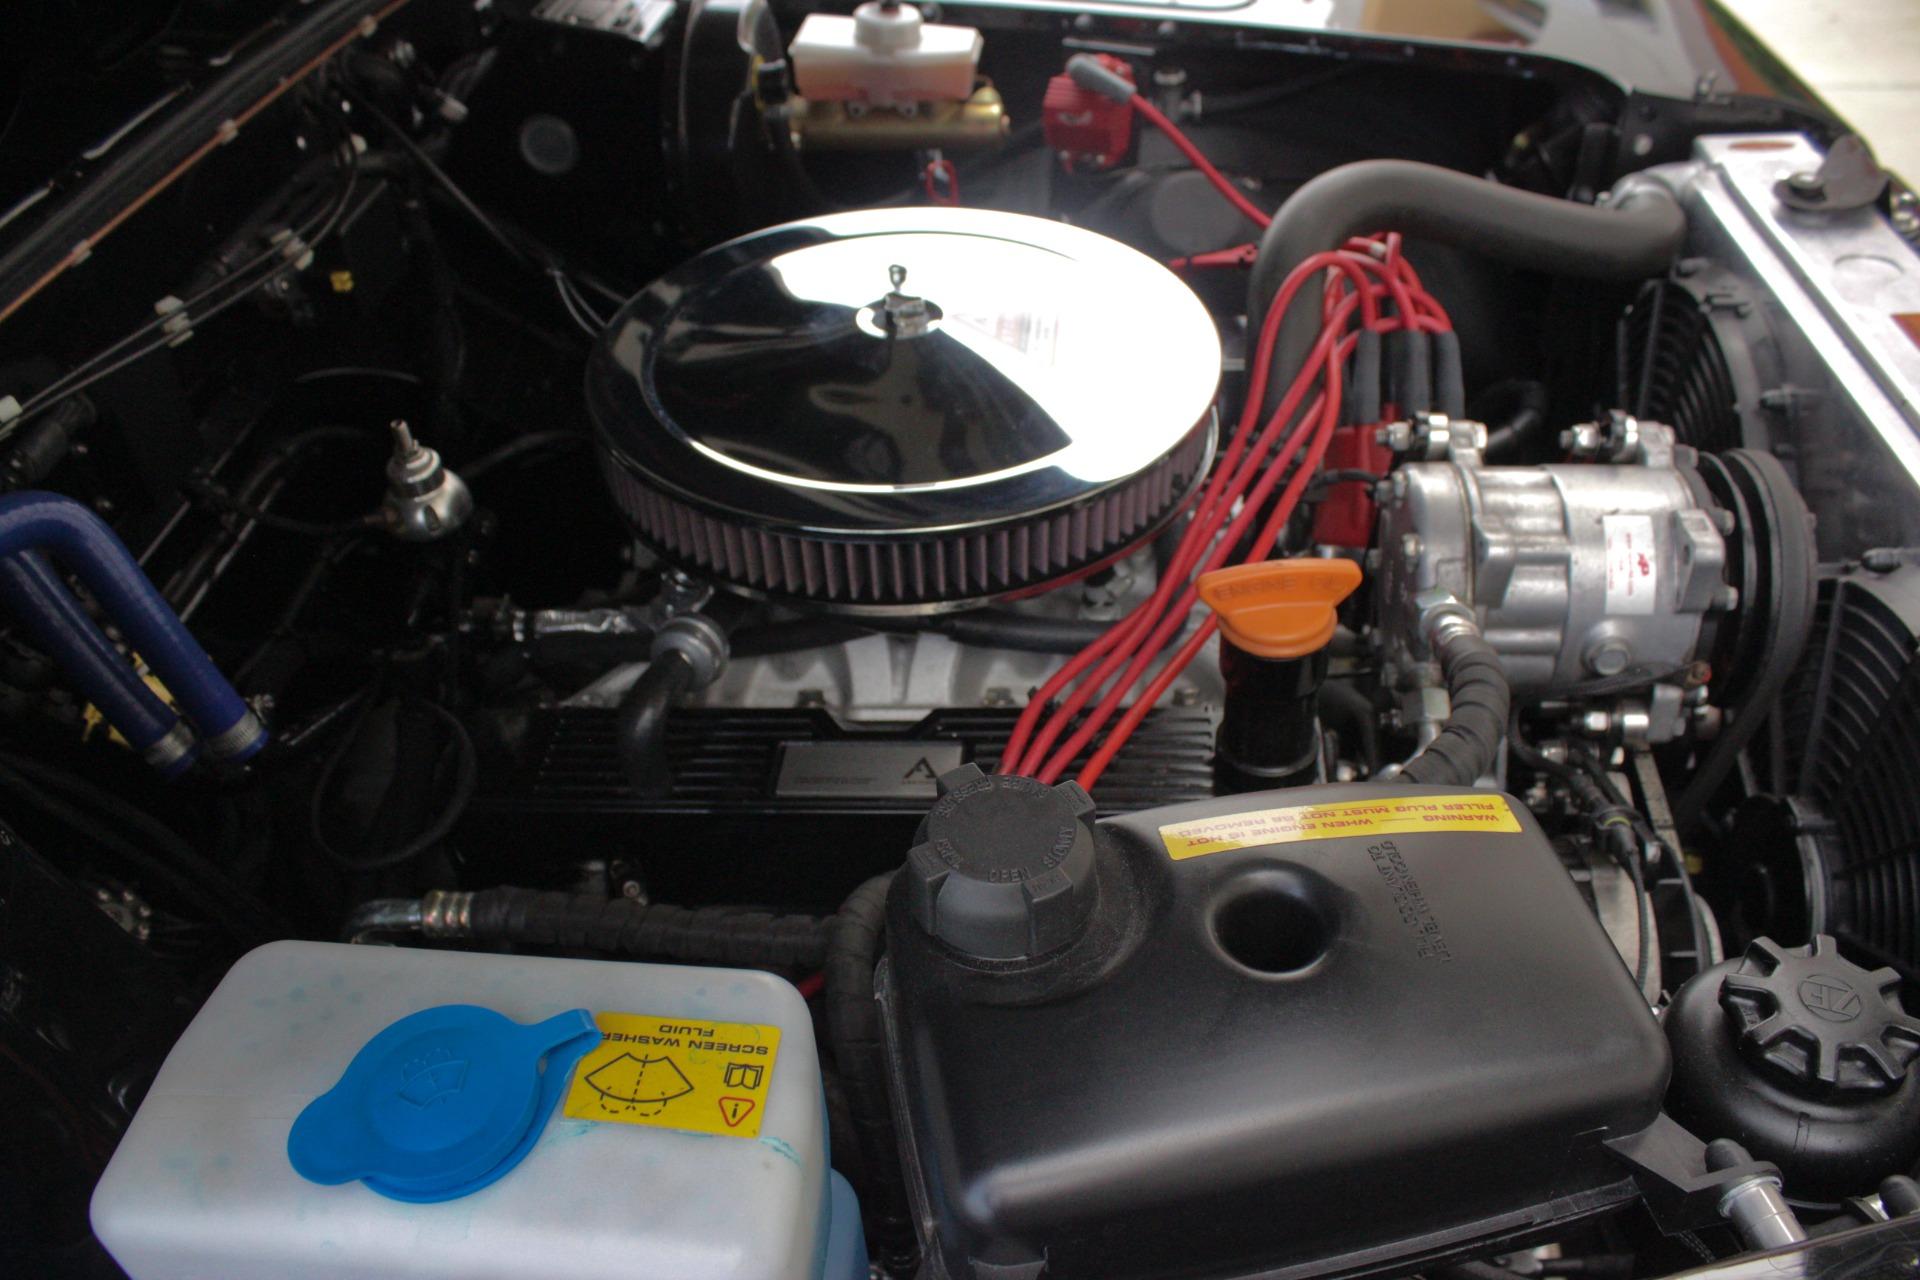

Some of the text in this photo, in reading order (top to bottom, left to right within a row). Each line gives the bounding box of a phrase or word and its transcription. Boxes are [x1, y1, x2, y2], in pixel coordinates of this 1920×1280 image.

[1342, 806, 1390, 818] MUST
[1394, 803, 1439, 815] PLUG
[1442, 802, 1495, 813] FILLER
[1300, 809, 1336, 821] NOT
[1421, 813, 1499, 824] WARNING
[1177, 818, 1267, 838] REMOVED
[1319, 817, 1374, 828] WHEN
[1251, 822, 1317, 837] ENGINE
[1185, 834, 1223, 848] NOT
[987, 866, 1032, 883] OPEN
[658, 1023, 716, 1037] FLUID
[687, 1039, 769, 1056] SCREEN
